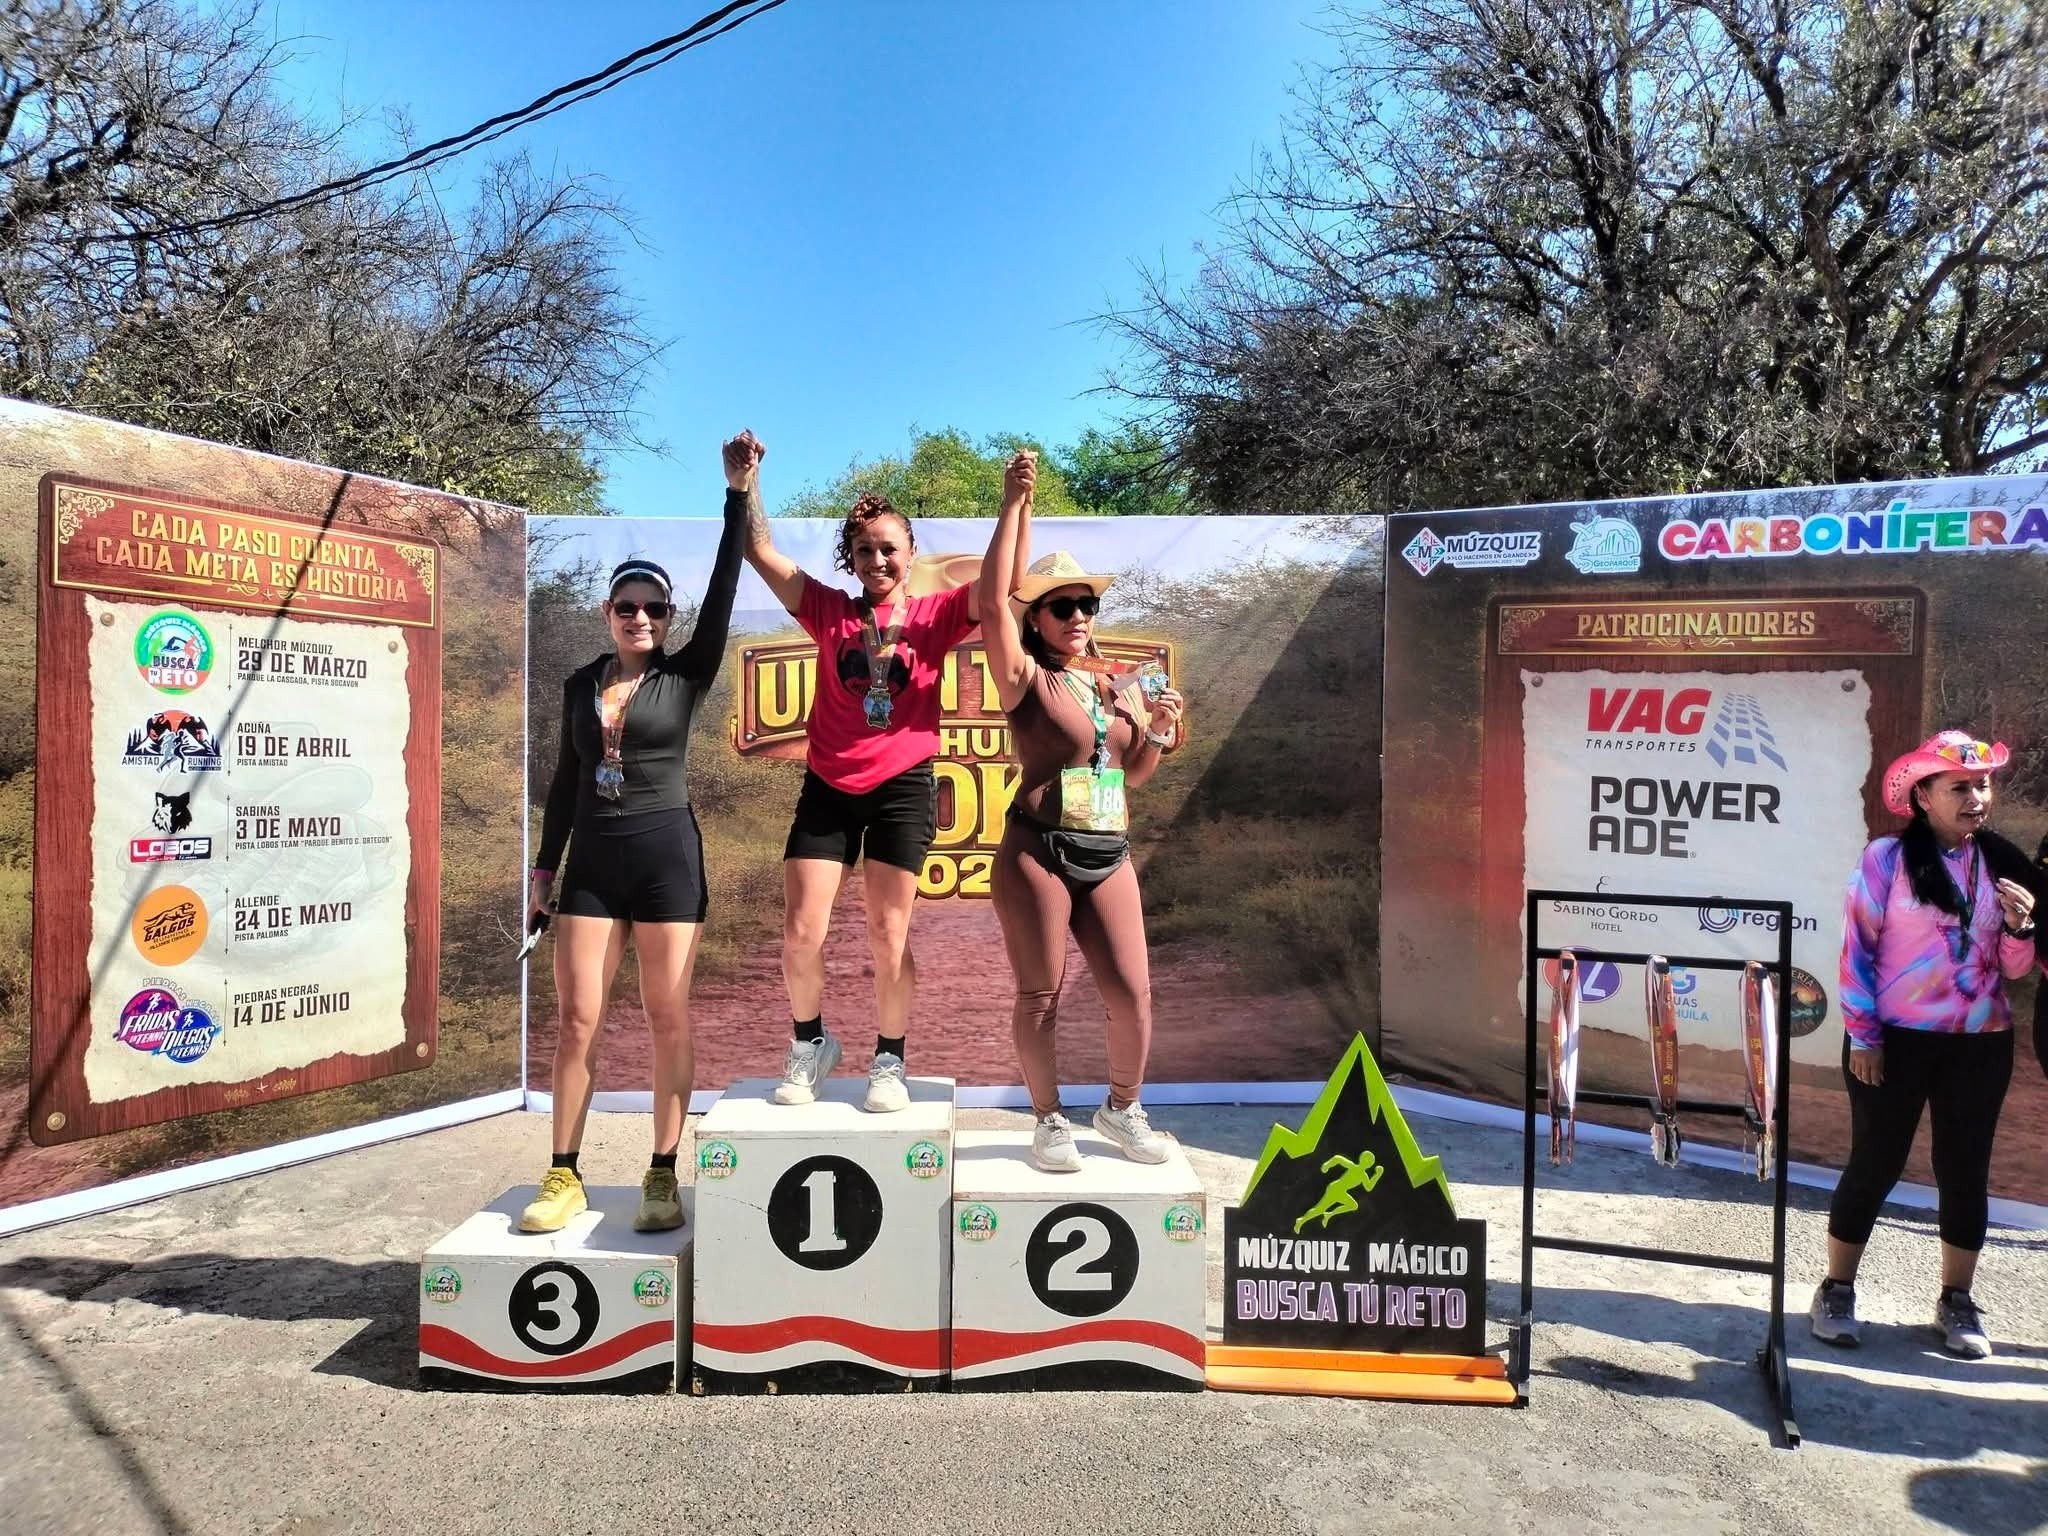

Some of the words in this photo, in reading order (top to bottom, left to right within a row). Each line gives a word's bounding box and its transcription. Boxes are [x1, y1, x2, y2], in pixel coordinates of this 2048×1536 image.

[1662, 502, 2048, 556] CARBONÍFERA
[132, 510, 208, 547] CADA
[218, 523, 281, 557] PASO
[290, 536, 384, 574] CUENTA,
[1447, 535, 1538, 553] MÚZQUIZ
[96, 536, 174, 573] CADA
[185, 550, 259, 583] META
[270, 561, 297, 588] ES
[307, 567, 408, 602] HISTORIA
[1594, 559, 1639, 567] GEOPARQUE
[1577, 611, 1815, 636] PATROCINADORES
[239, 637, 287, 651] MELCHOR
[290, 640, 333, 655] MÚZQUIZ
[153, 656, 194, 669] BUSCA
[239, 650, 261, 671] 29
[271, 652, 295, 673] DE
[303, 655, 367, 679] MARZO
[148, 668, 198, 687] RETO
[238, 673, 264, 681] PARQUE
[311, 678, 329, 686] PISTA
[1587, 687, 1712, 735] VAG
[237, 722, 271, 734] ACUÑA
[238, 736, 256, 756] 19
[265, 736, 288, 756] DE
[296, 737, 351, 757] ABRIL
[1585, 738, 1697, 753] TRANSPORTES
[122, 757, 160, 766] AMISTAD
[188, 757, 221, 766] RUNNING
[1590, 775, 1781, 824] POWER
[236, 805, 280, 817] SABINAS
[236, 819, 247, 839] 3
[256, 818, 280, 839] DE
[288, 817, 341, 838] MAYO
[1589, 815, 1689, 859] ADE
[133, 840, 209, 857] LOBOS
[235, 842, 255, 850] PISTA
[257, 841, 278, 849] LOBOS
[281, 840, 298, 848] TEAM
[235, 895, 279, 908] ALLENDE
[1553, 901, 1605, 917] SABINO
[1609, 906, 1658, 923] GORDO
[235, 909, 260, 931] 24
[268, 907, 292, 928] DE
[300, 902, 352, 925] MAYO
[1591, 921, 1623, 933] HOTEL
[1742, 911, 1817, 931] regon
[144, 916, 195, 942] GALGOS
[235, 932, 254, 942] PISTA
[256, 929, 289, 940] PALOMAS
[143, 977, 187, 1001] PIEDRAS
[234, 988, 277, 1005] PIEDRAS
[280, 984, 319, 999] NEGRAS
[233, 1003, 253, 1027] 14
[261, 1001, 285, 1024] DE
[294, 992, 350, 1018] JUNIO
[120, 1010, 180, 1038] FRIDAS
[159, 1026, 215, 1052] DIEGOS
[799, 1171, 846, 1252] 1
[1047, 1216, 1112, 1291] 2
[1239, 1233, 1350, 1273] MÚZQUIZ
[1369, 1239, 1468, 1275] MÁGICO
[527, 1271, 580, 1344] 3
[1237, 1280, 1338, 1322] BUSCA
[1344, 1279, 1379, 1324] TÚ
[1386, 1285, 1466, 1328] RETO
